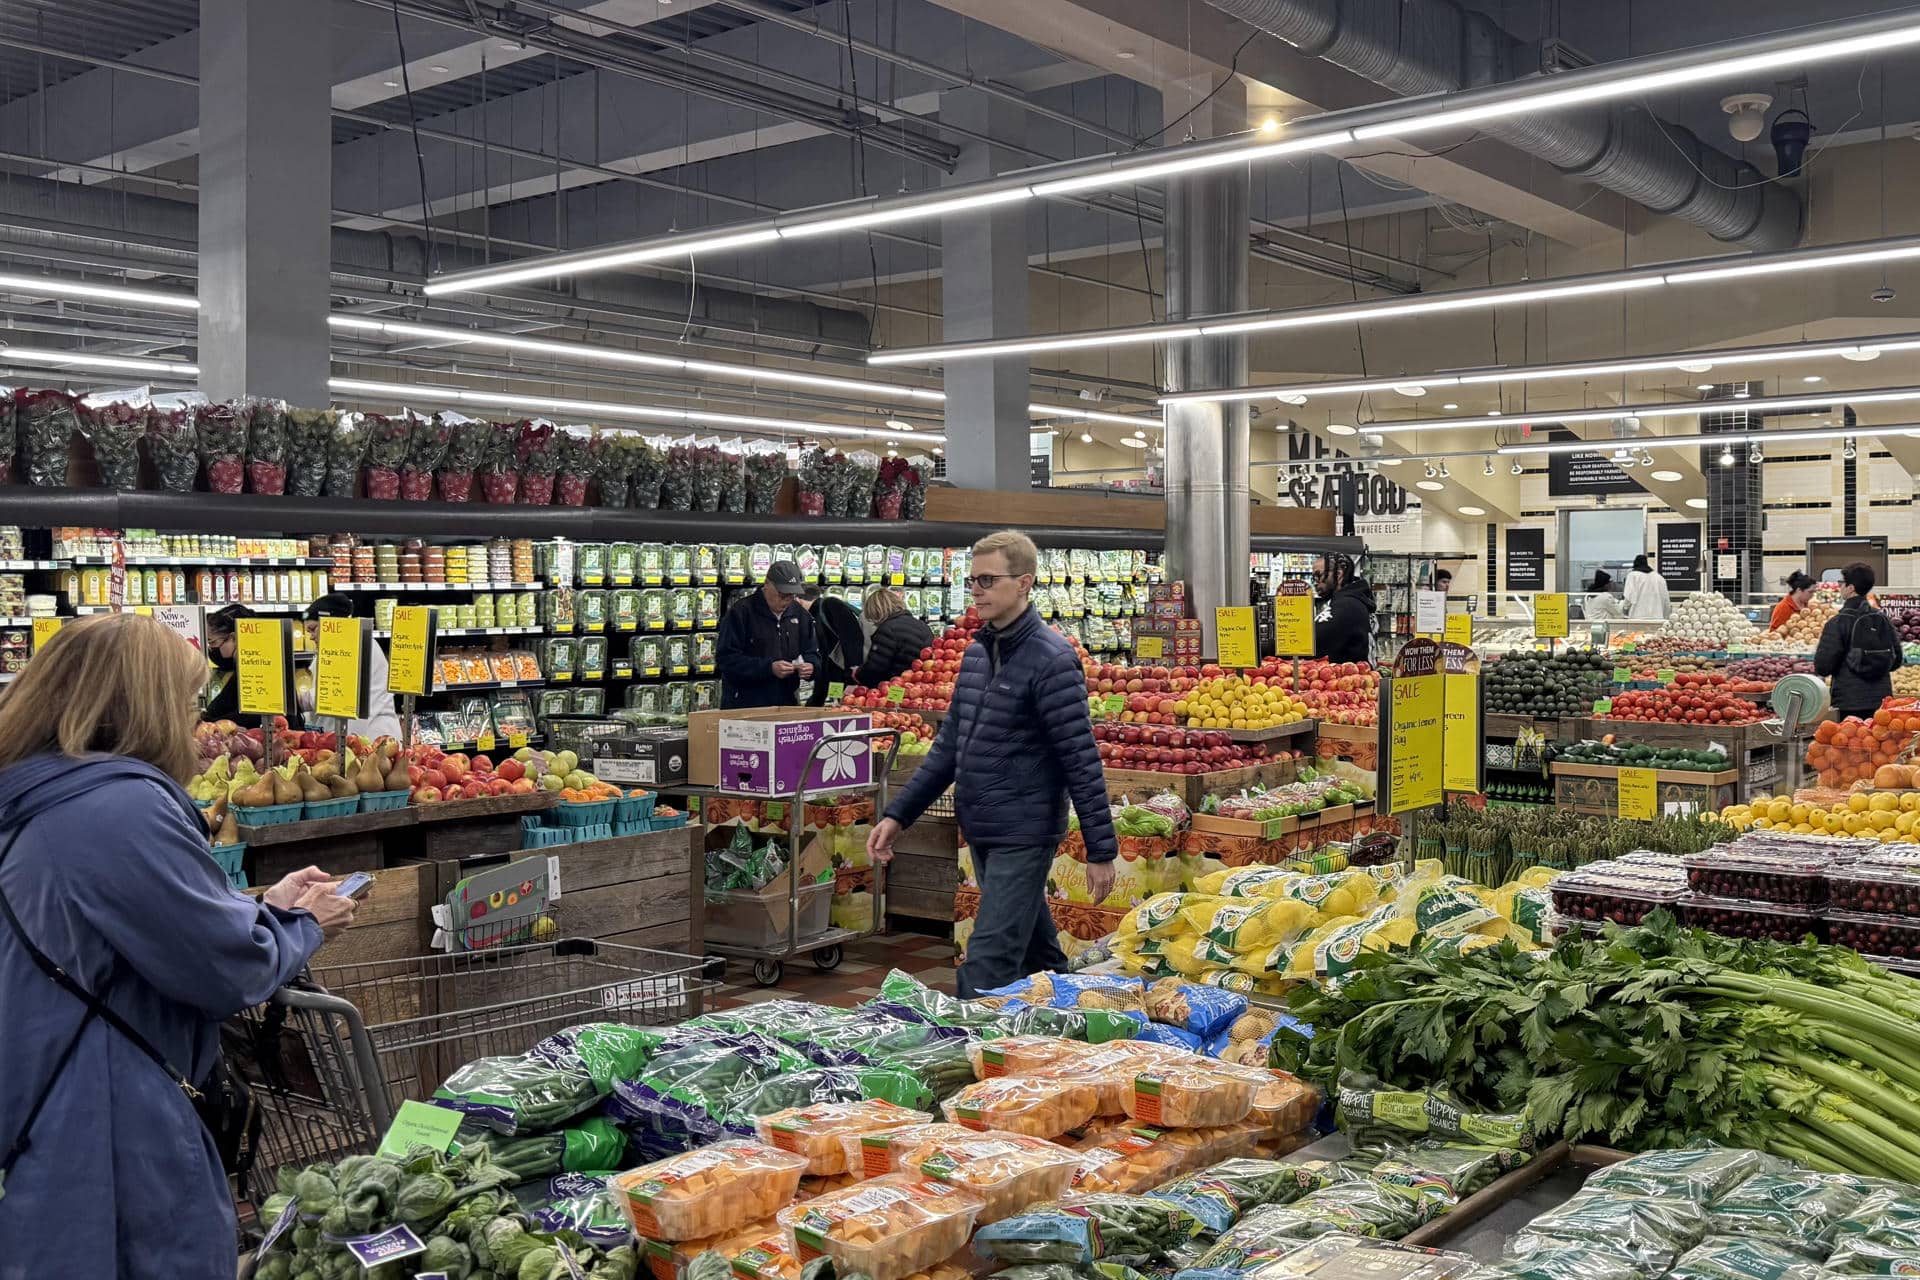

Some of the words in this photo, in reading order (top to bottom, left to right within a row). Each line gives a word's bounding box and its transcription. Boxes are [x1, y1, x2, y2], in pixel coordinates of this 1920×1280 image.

[1289, 473, 1406, 516] SEAOOD
[1385, 523, 1401, 534] ELSE
[161, 611, 178, 620] Now
[395, 609, 412, 620] SALE
[1218, 608, 1237, 617] SALE
[240, 622, 262, 634] SALE
[321, 621, 342, 633] SALE
[1420, 645, 1434, 655] THEM
[1443, 648, 1465, 656] THEM
[1419, 655, 1434, 671] LESS
[1445, 657, 1464, 670] ESS
[1394, 681, 1423, 699] SALE
[1444, 711, 1465, 720] reen
[778, 725, 810, 736] organics
[1393, 720, 1417, 734] Organic
[778, 732, 815, 744] superfresh
[1393, 735, 1406, 747] Bag
[1426, 1096, 1458, 1119] HIPPIE
[1429, 1117, 1457, 1131] RGANICS
[1726, 1251, 1770, 1273] BEANS
